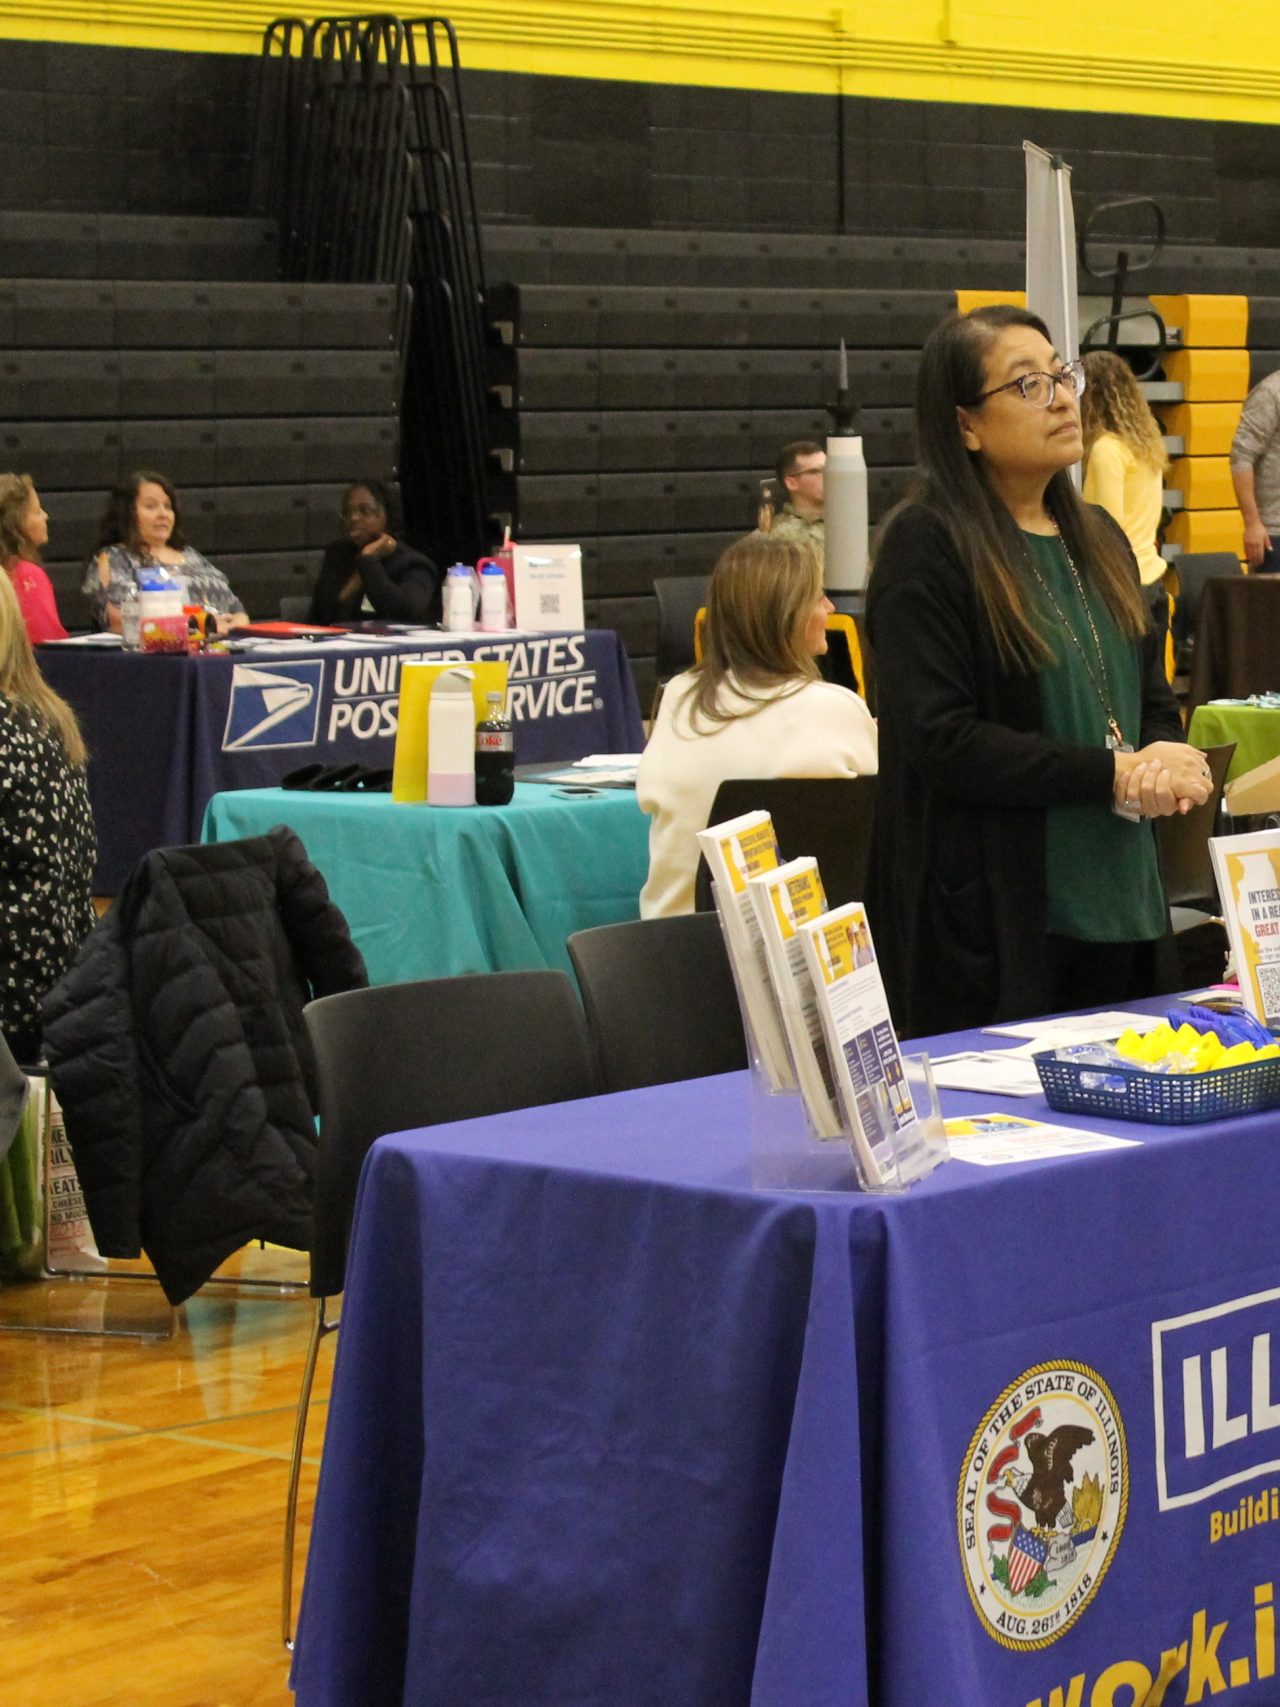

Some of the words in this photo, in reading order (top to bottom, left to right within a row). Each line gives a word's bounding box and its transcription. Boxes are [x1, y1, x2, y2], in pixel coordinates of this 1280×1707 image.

[1251, 907, 1261, 921] IN
[1262, 907, 1268, 920] A
[1254, 922, 1280, 938] GREAT
[965, 1480, 980, 1550] SEAL
[973, 1439, 989, 1473] OF
[989, 1394, 1024, 1434] THE
[1025, 1375, 1075, 1400] STATE
[1077, 1381, 1098, 1402] OF
[1096, 1399, 1120, 1495] ILLINOIS
[997, 1610, 1030, 1637] AUG.
[1064, 1573, 1093, 1616] 1818
